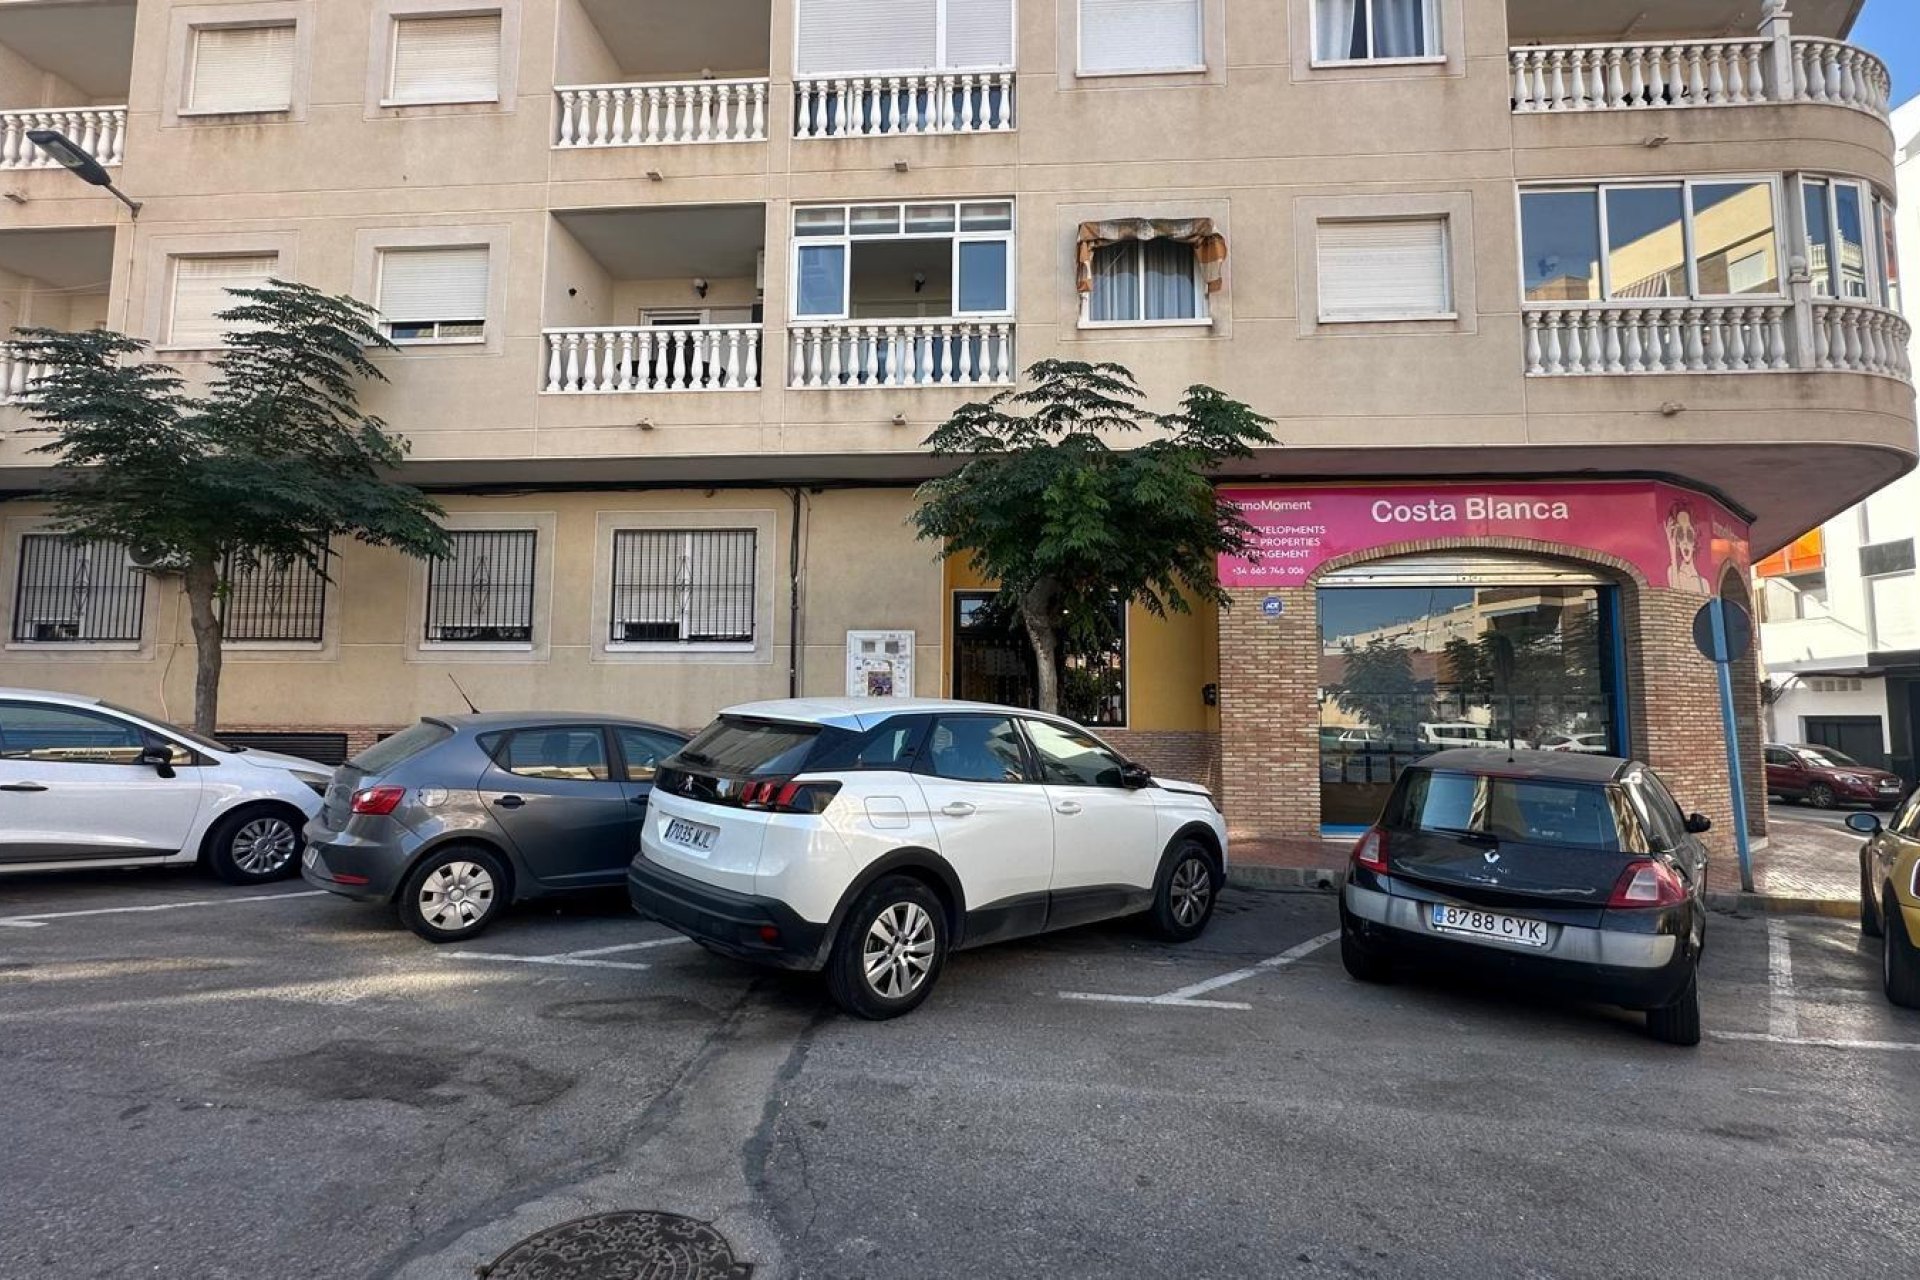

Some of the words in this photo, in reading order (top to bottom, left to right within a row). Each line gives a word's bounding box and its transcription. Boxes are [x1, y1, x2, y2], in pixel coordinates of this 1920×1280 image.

[1371, 499, 1456, 523] Costa
[1465, 497, 1569, 520] Blanca
[1260, 538, 1321, 547] PROPERTIES
[1232, 566, 1247, 575] +34
[669, 823, 694, 842] 7035
[1446, 908, 1495, 931] 8788
[1502, 917, 1540, 940] CYK
